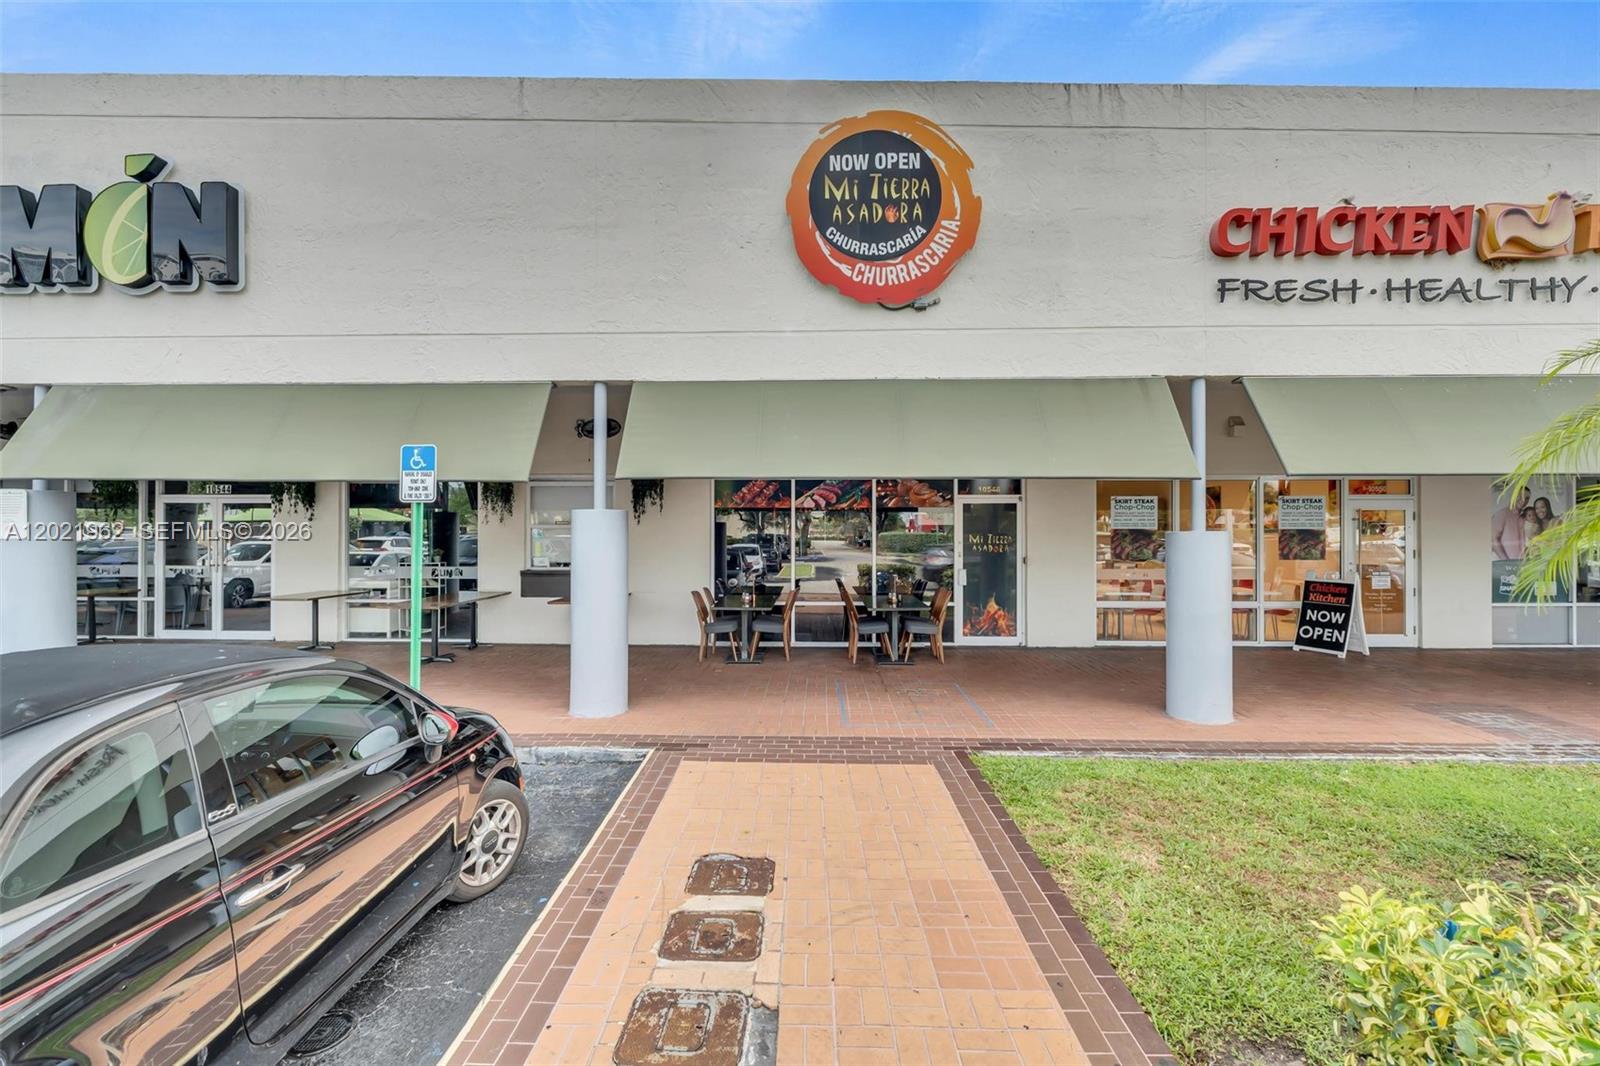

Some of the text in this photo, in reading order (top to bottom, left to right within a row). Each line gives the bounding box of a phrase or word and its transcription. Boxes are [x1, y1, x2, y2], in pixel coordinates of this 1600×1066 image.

[829, 152, 921, 172] NOW OPEN
[1209, 204, 1476, 258] CHICKEN
[851, 218, 961, 287] CHURRASCARIA
[1217, 274, 1588, 304] FRESH HEALTHY
[1309, 593, 1346, 604] Kitchen
[1310, 584, 1347, 594] Chicken
[1306, 609, 1345, 624] NOW
[1299, 625, 1346, 643] OPEN
